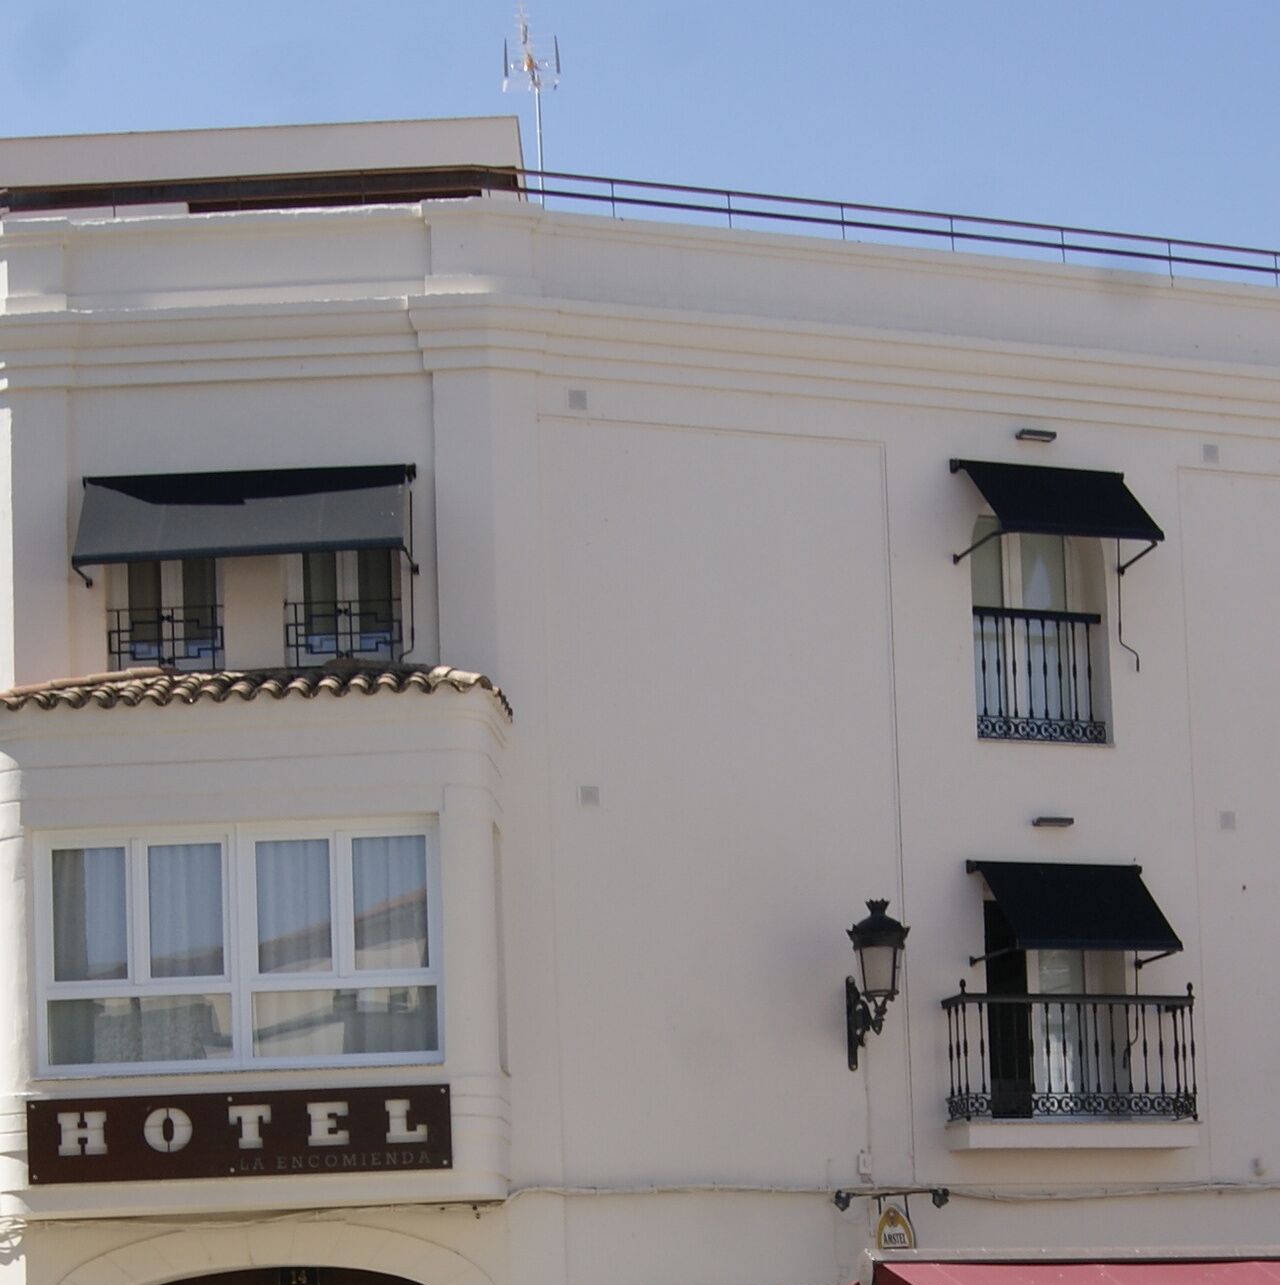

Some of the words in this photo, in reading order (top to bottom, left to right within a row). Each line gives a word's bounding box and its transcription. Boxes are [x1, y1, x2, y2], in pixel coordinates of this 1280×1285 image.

[56, 1098, 429, 1157] HOTEL
[239, 1156, 265, 1171] LA
[276, 1151, 432, 1170] ENCOMIENDA
[883, 1232, 907, 1246] AMSTEL
